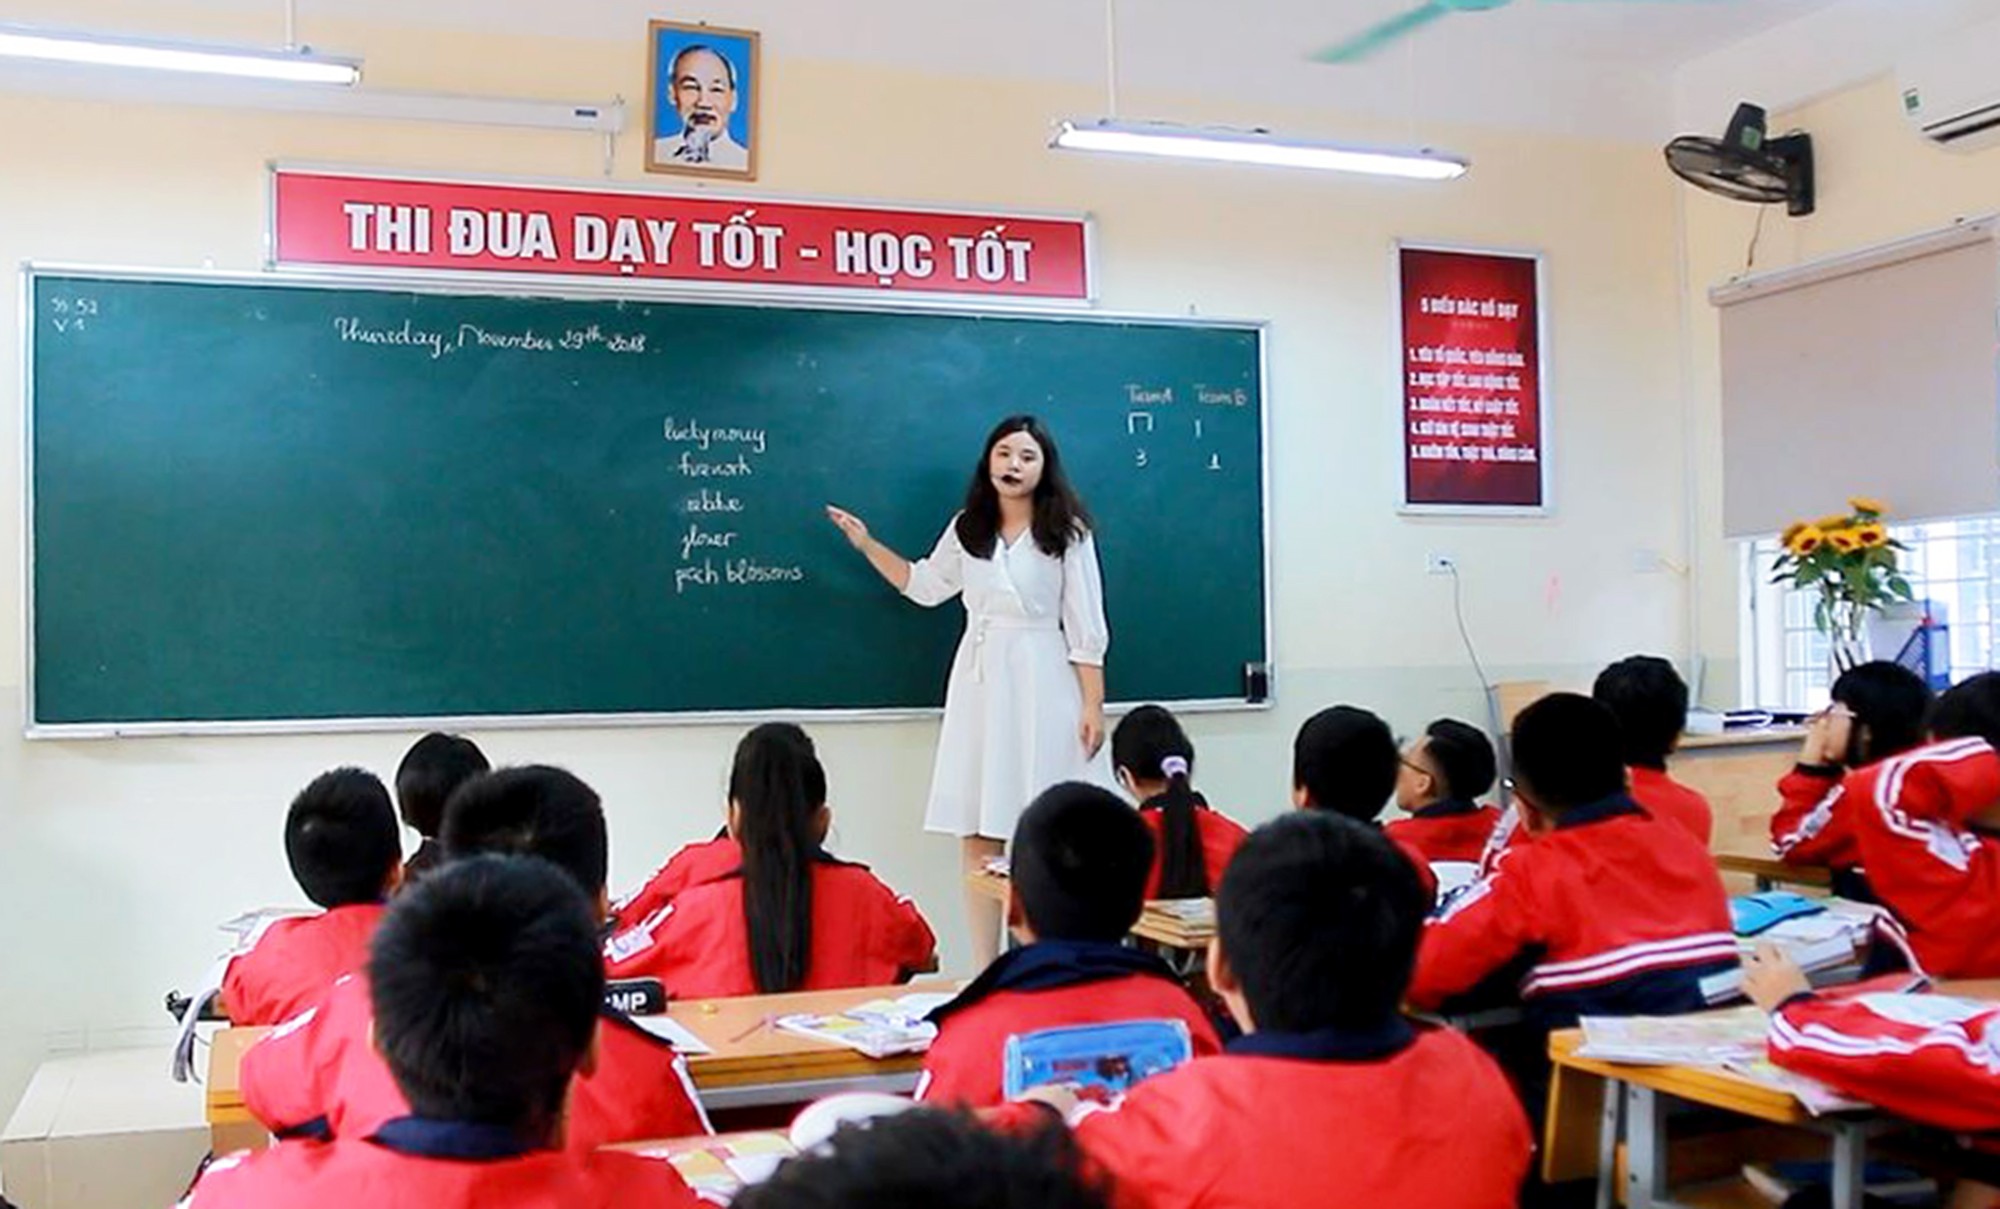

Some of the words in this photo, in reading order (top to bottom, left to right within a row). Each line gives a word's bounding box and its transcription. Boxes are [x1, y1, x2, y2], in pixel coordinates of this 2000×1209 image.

[343, 203, 431, 253] THI
[448, 209, 558, 260] ĐUA
[574, 215, 677, 273] DẠY
[693, 209, 784, 270] TỐT
[834, 229, 934, 285] HỌC
[947, 224, 1032, 282] TỐT
[458, 323, 553, 351] November
[605, 991, 648, 1012] MP
